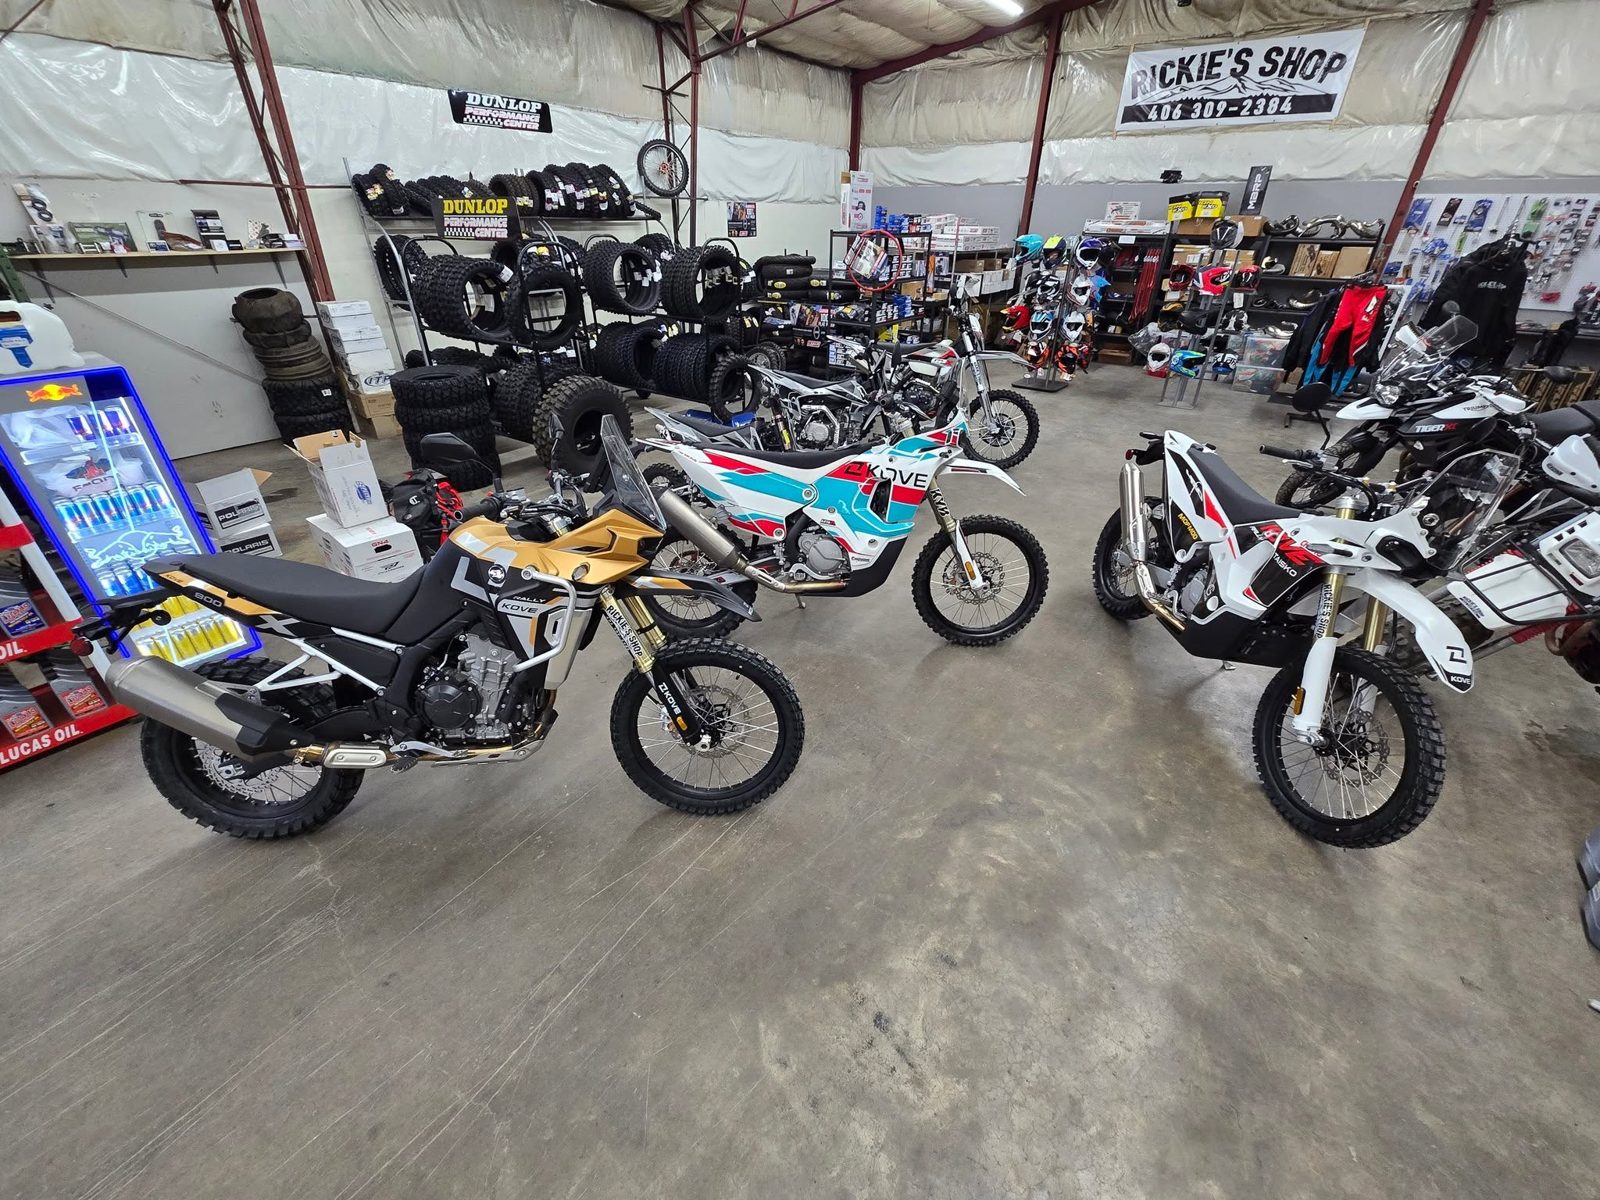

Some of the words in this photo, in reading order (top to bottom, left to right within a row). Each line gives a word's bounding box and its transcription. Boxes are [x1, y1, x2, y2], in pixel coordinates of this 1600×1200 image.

[1131, 48, 1253, 99] RICKIE'S
[1258, 46, 1347, 84] SHOP
[466, 92, 542, 112] DUNLOP
[1148, 104, 1181, 121] 406
[1191, 96, 1292, 119] 309-2384
[464, 107, 540, 122] PERFORMANCE
[503, 119, 539, 130] CENTER
[1247, 173, 1264, 210] MBRP
[443, 199, 508, 214] DUNLOP
[444, 217, 508, 227] PERFORMANCE
[474, 228, 508, 238] CENTER
[1415, 424, 1445, 433] TIGER
[867, 463, 929, 488] KOVE
[931, 488, 950, 517] KYB
[371, 539, 389, 547] GN4
[1273, 552, 1297, 577] TAISKO
[501, 602, 539, 614] KOVE
[513, 595, 546, 603] RALLY
[1322, 584, 1333, 616] RICKIE'S
[606, 605, 632, 636] RICKIE'S
[629, 635, 643, 657] SHOP
[1315, 618, 1329, 638] SHOP
[1450, 675, 1471, 685] KOVE
[664, 689, 681, 715] KOVE
[0, 735, 52, 765] LUCAS
